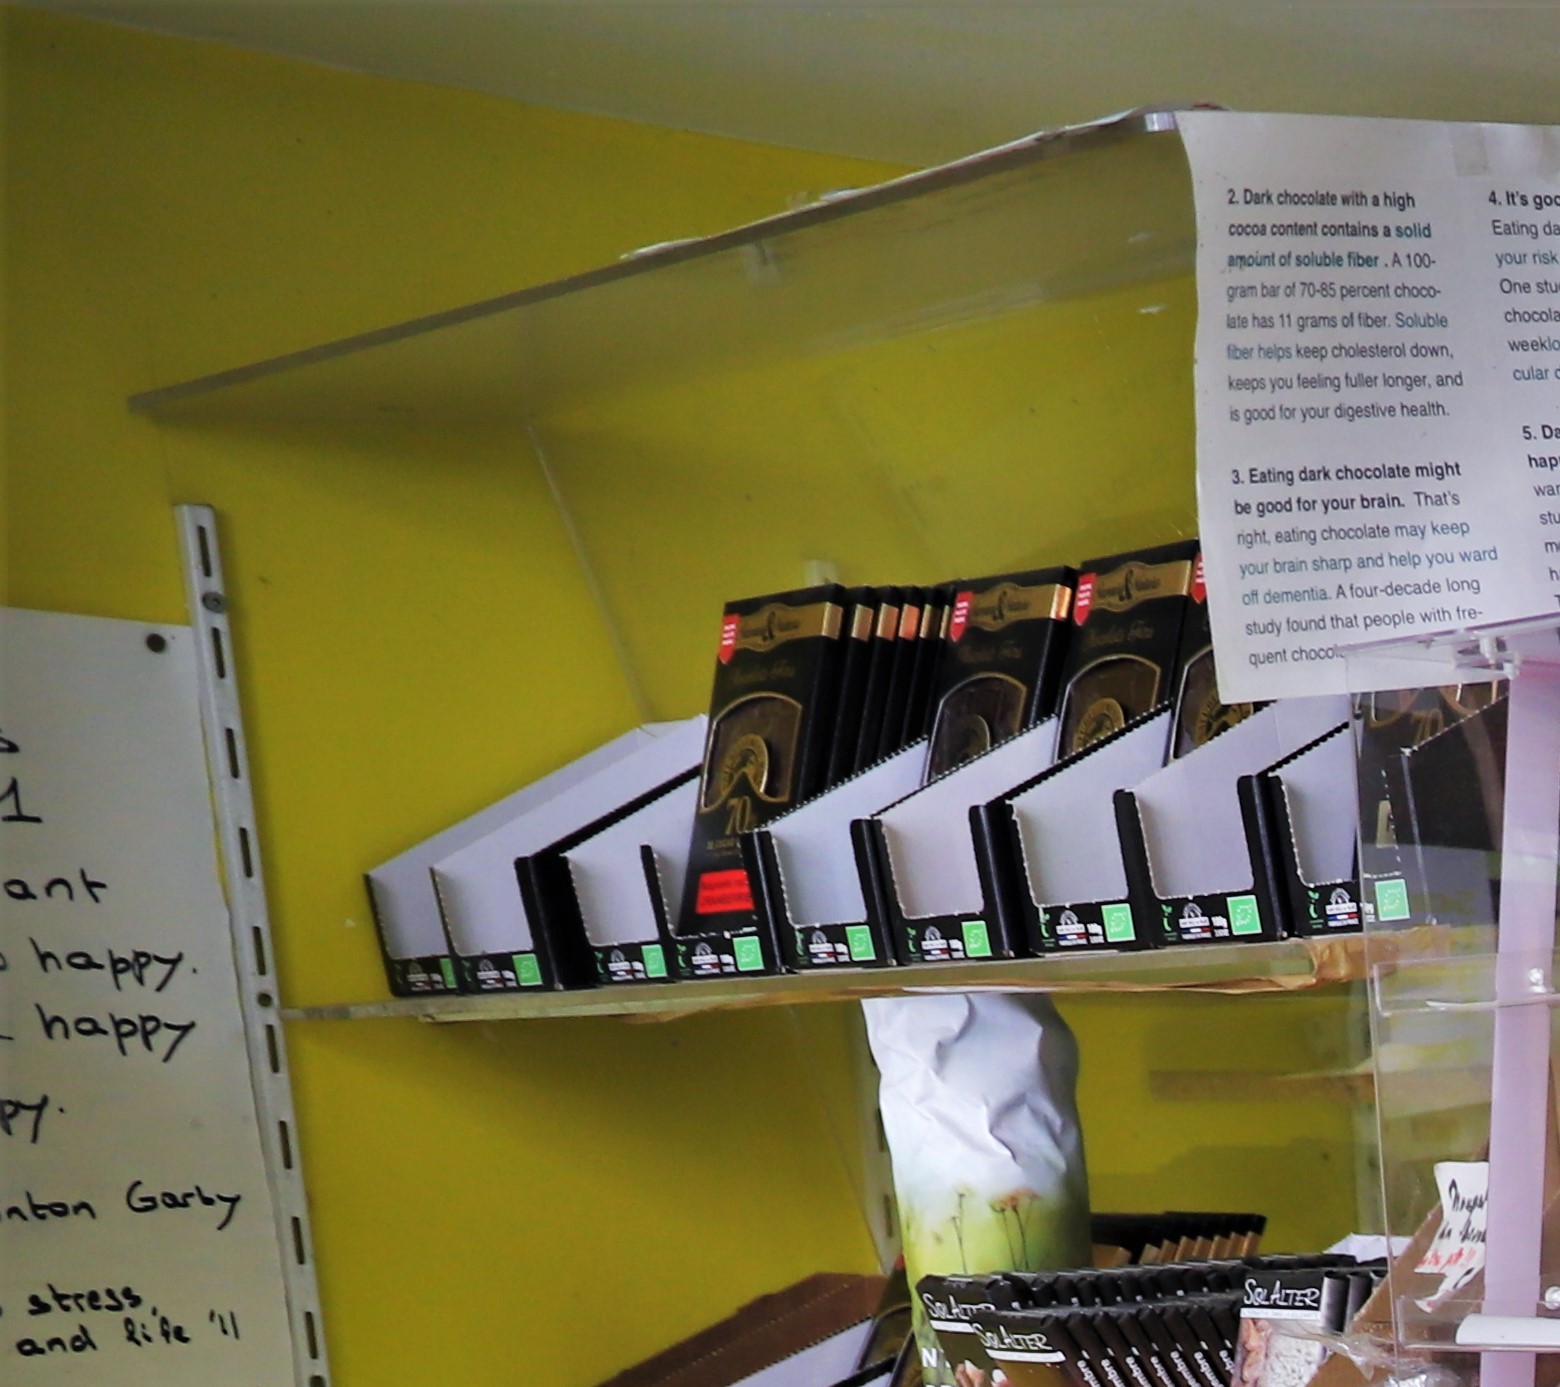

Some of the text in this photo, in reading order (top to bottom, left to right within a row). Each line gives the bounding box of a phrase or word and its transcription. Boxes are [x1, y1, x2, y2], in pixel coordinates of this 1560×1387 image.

[1227, 187, 1416, 212] 2. Dark chocolate with a high
[1488, 189, 1502, 208] 4.
[1505, 189, 1529, 208] It's
[1491, 218, 1539, 242] Eating
[1522, 421, 1540, 440] 5.
[1231, 460, 1462, 487] 3. Eating dark chocolate might
[1233, 489, 1460, 519] be good for your brain. That's
[1237, 519, 1470, 549] right, eating chocolate may keep
[35, 1003, 196, 1063] happy
[16, 1325, 97, 1356] and
